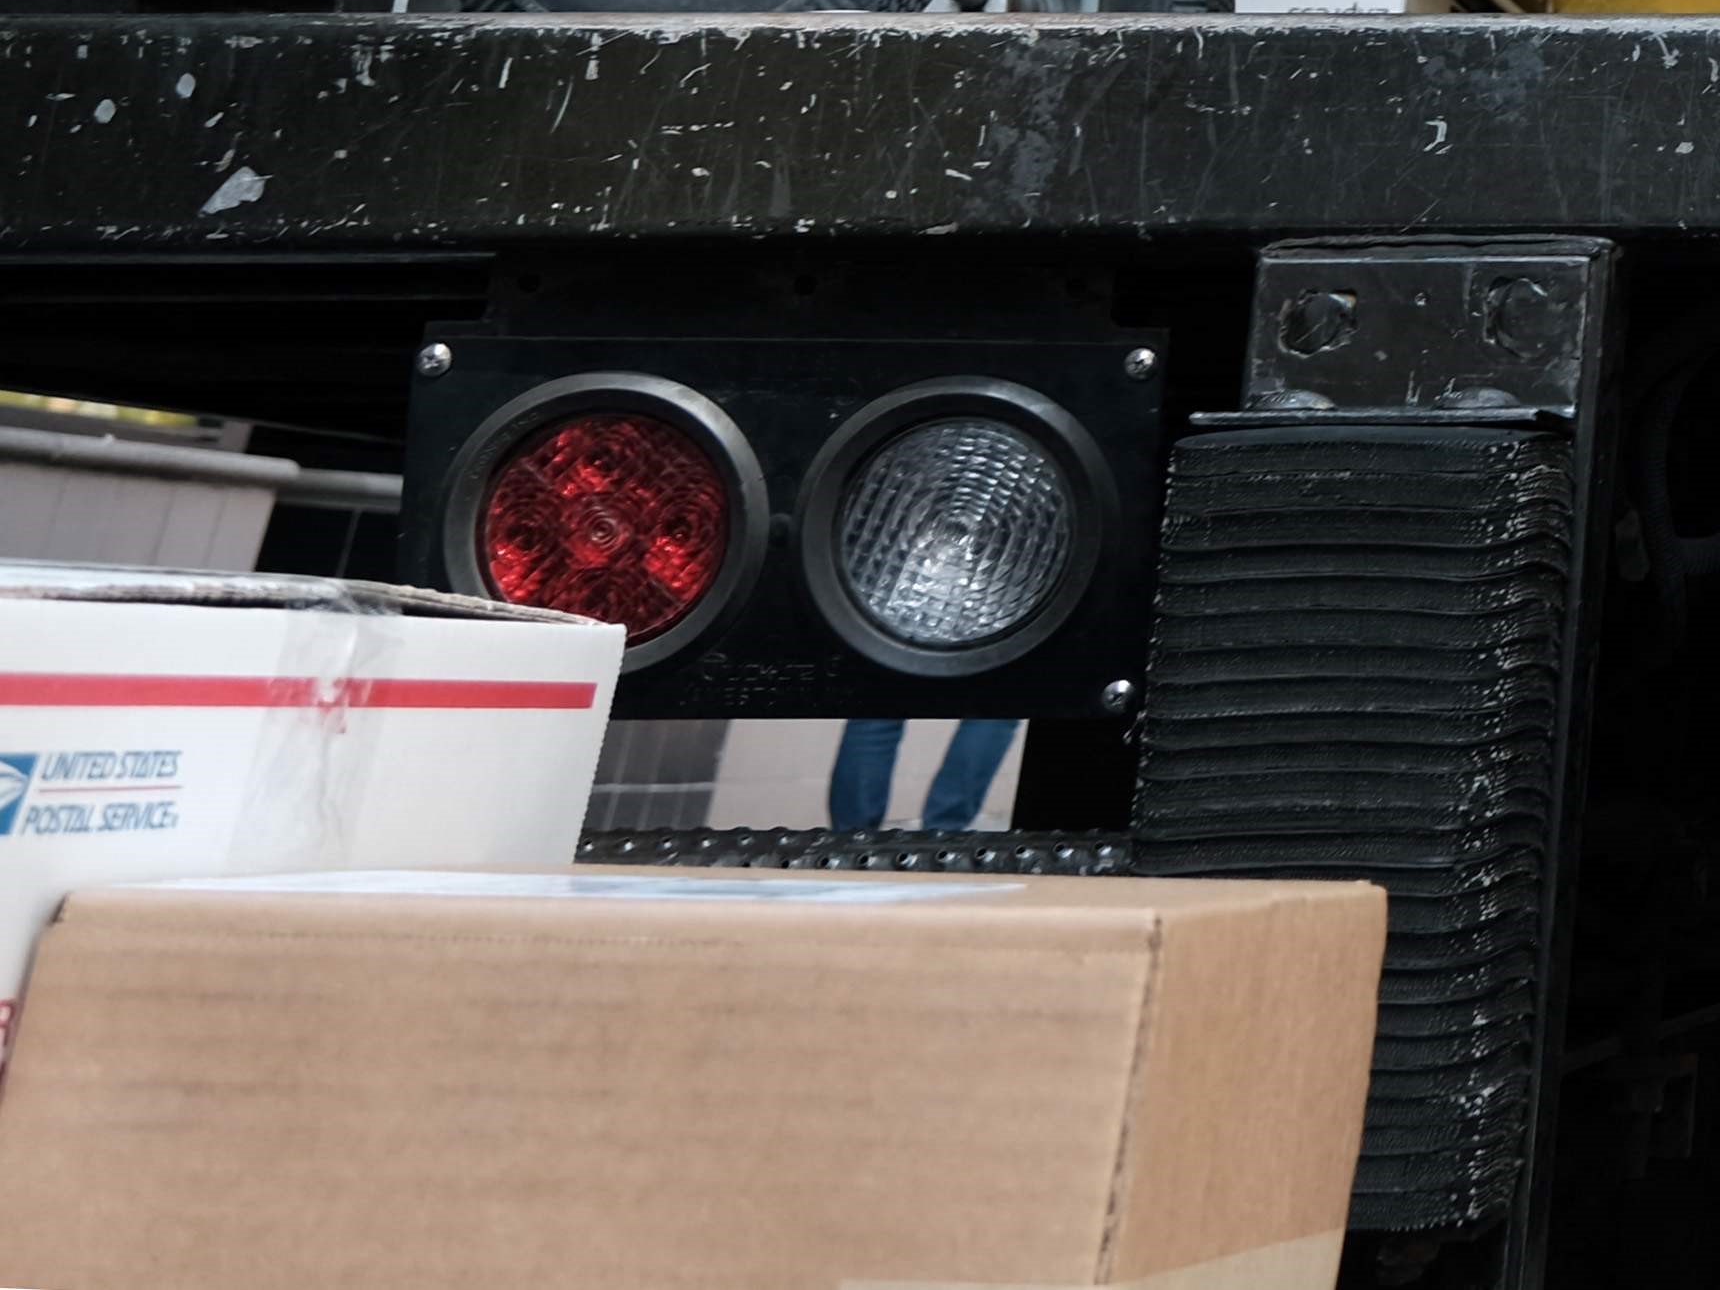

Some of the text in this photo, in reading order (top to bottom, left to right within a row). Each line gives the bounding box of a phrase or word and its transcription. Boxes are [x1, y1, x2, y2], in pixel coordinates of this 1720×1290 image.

[41, 750, 182, 780] UNITED STATES
[21, 805, 96, 836] POSTAL
